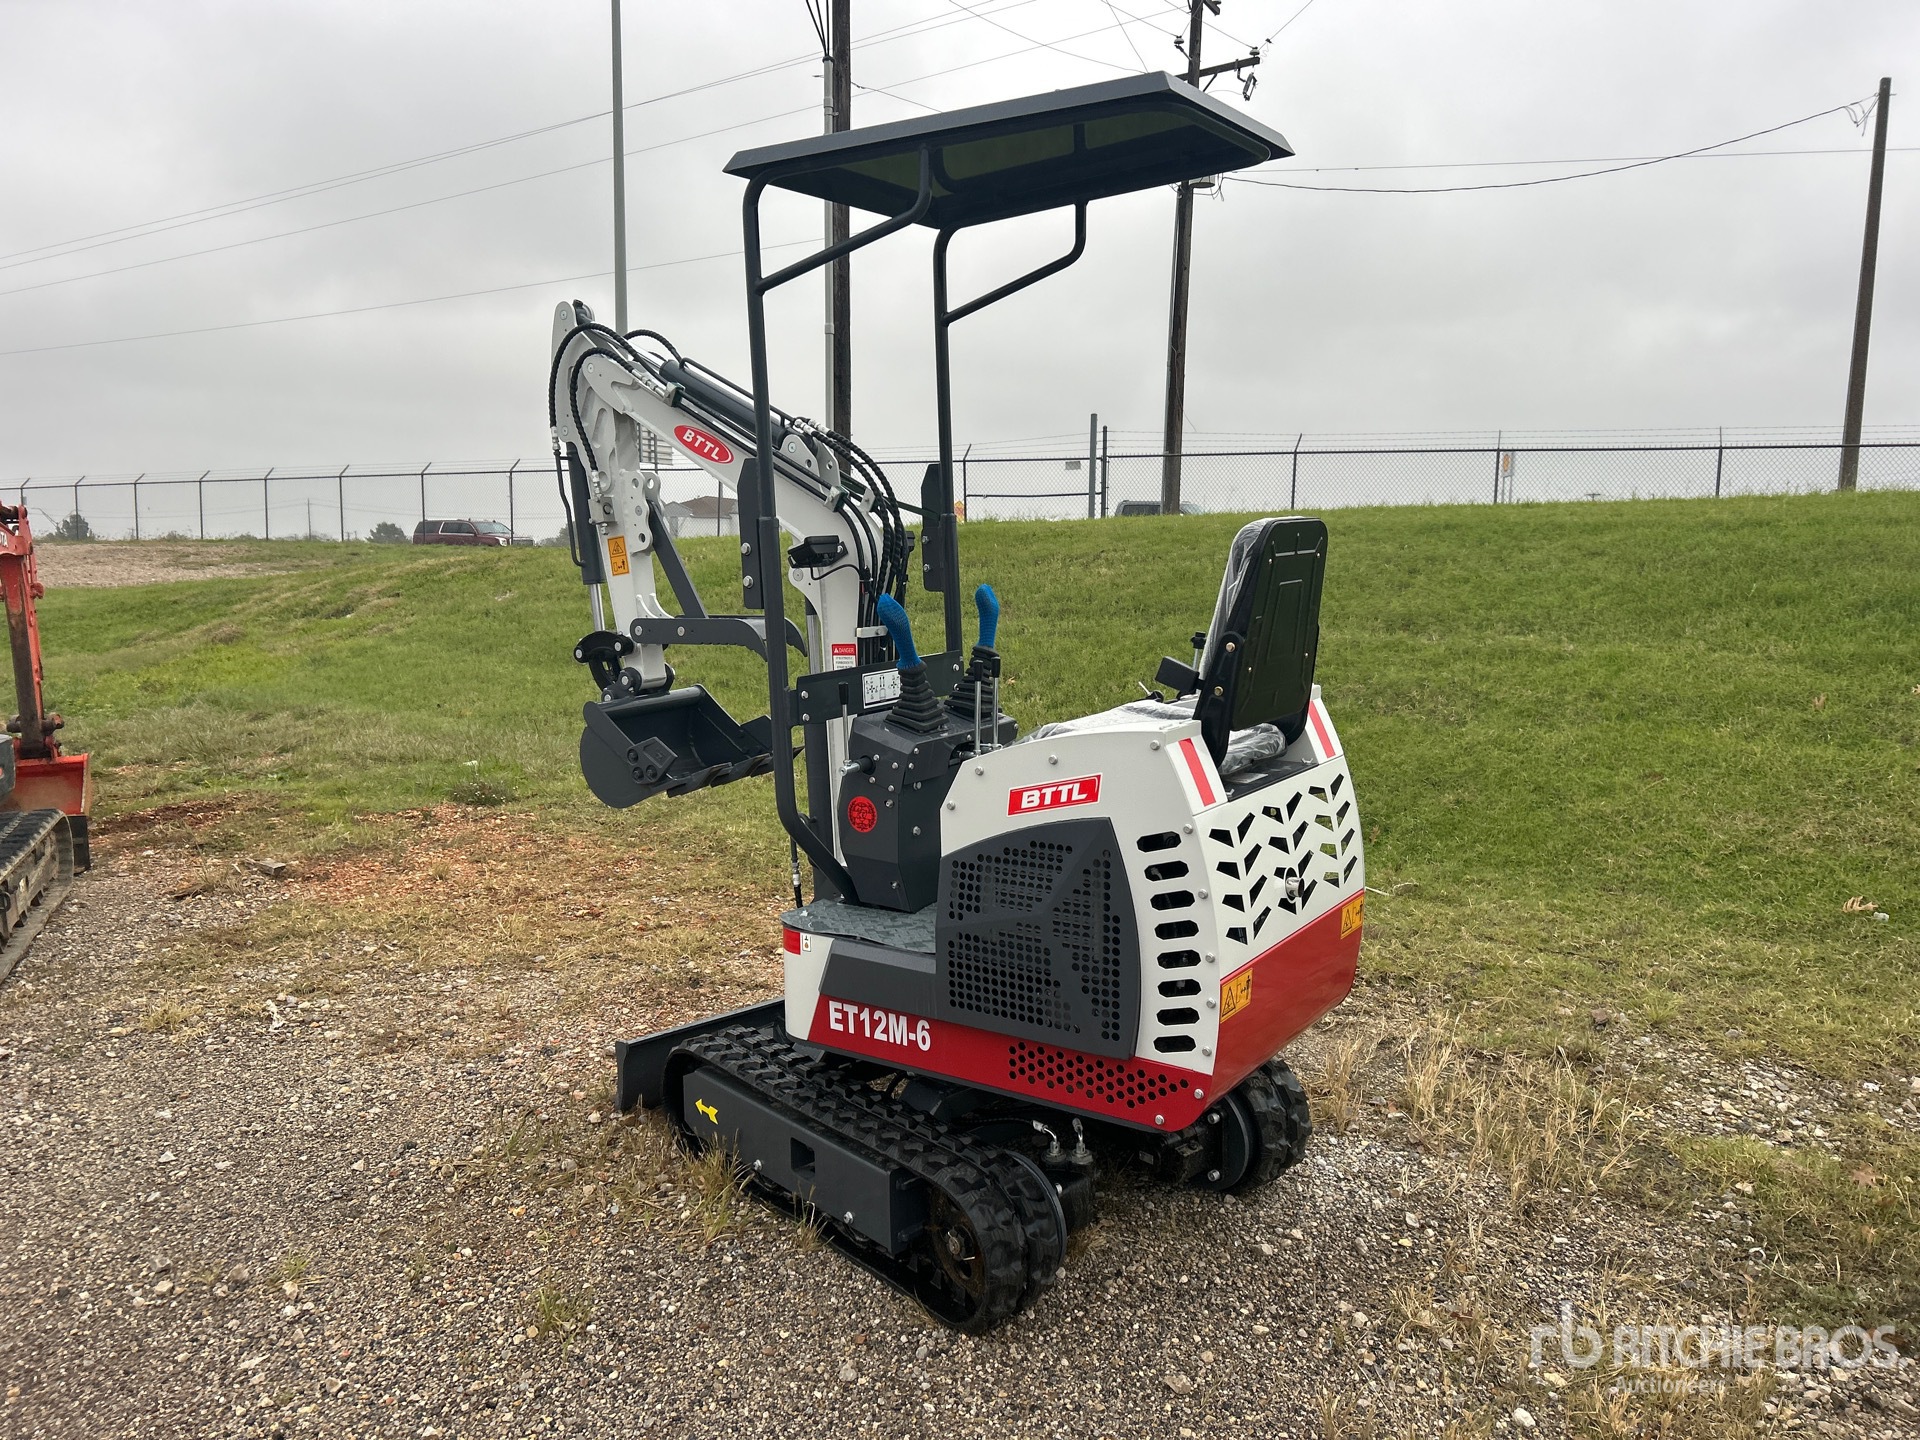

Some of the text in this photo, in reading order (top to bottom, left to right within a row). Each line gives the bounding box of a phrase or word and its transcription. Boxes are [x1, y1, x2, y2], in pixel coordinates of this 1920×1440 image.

[682, 429, 720, 460] BTTL
[1021, 782, 1088, 809] BTTL
[828, 1000, 931, 1052] ET12M-6
